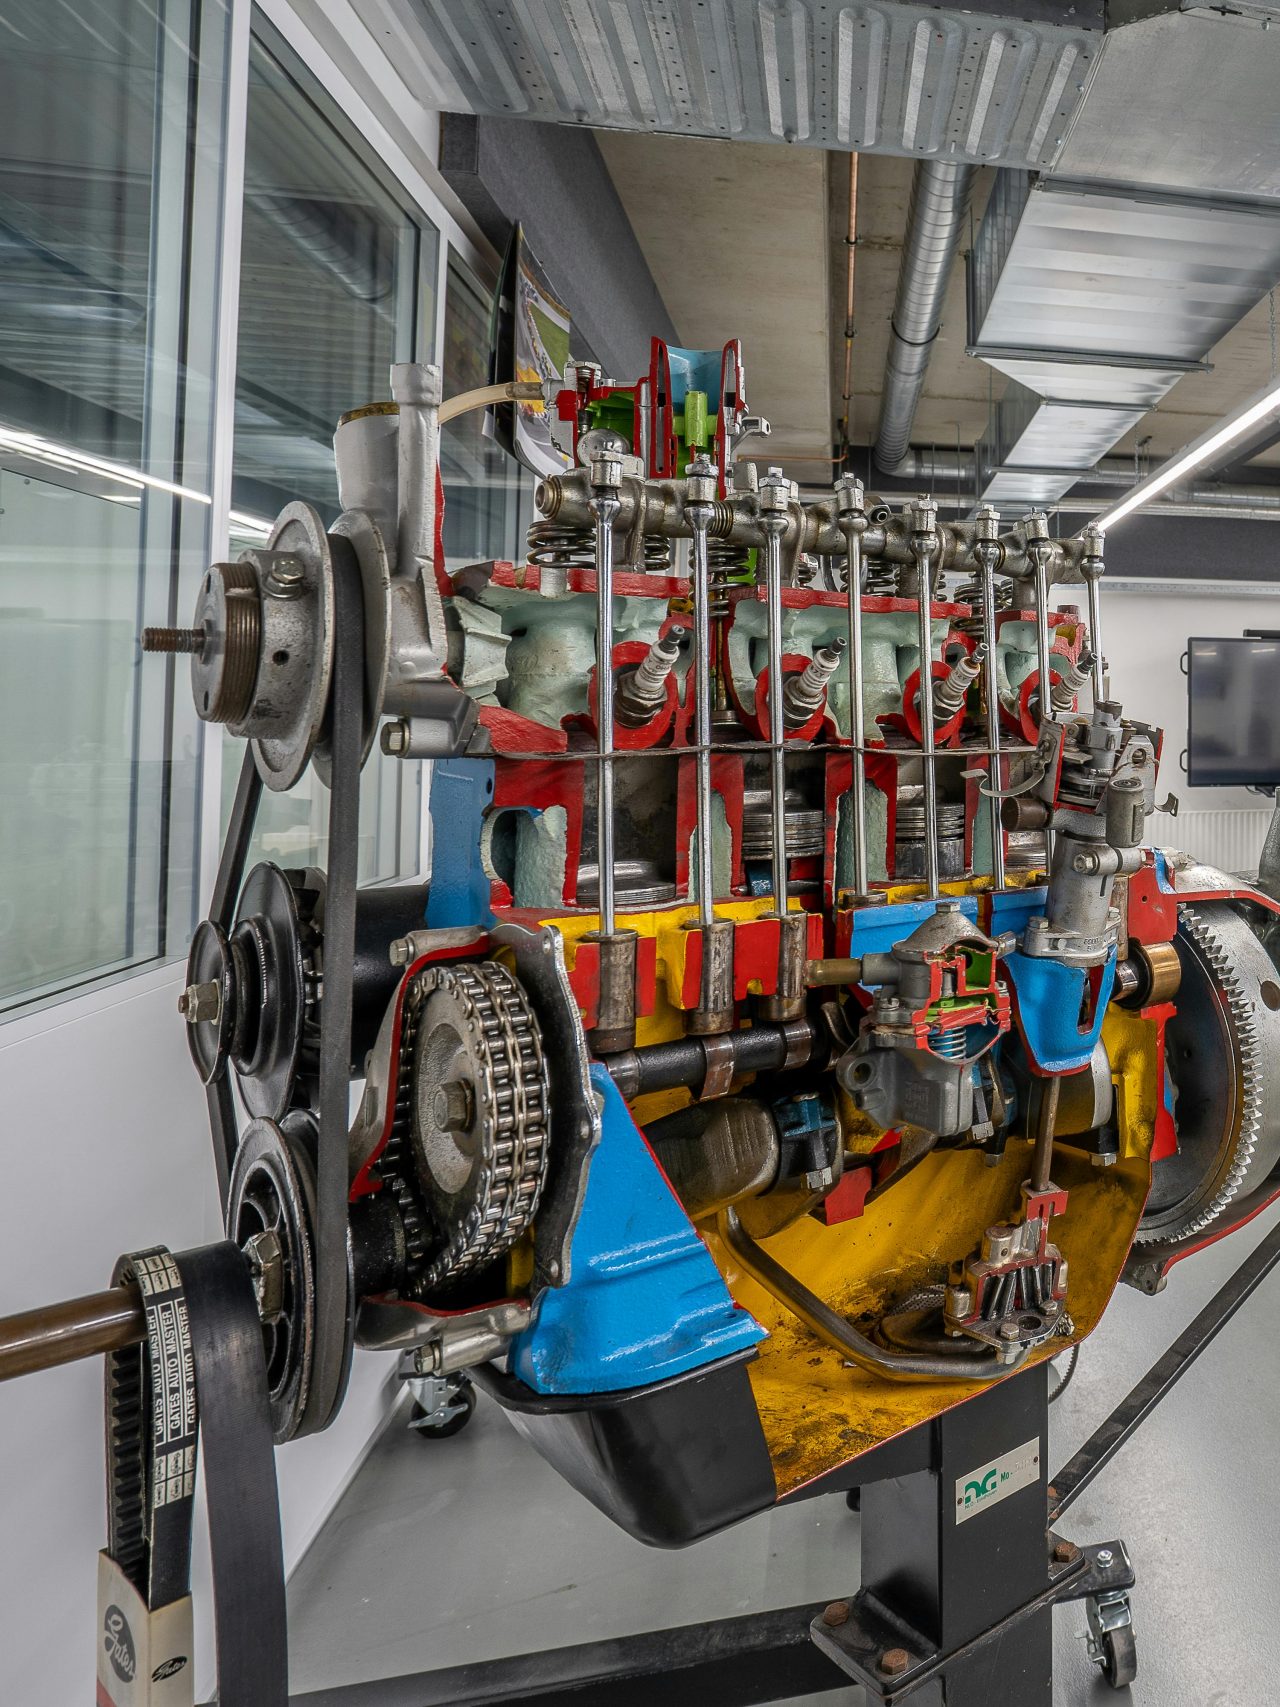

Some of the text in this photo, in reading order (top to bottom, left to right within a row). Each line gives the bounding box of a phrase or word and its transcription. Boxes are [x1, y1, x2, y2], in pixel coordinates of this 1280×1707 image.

[161, 1310, 182, 1430] GATES AUTO MASTER
[104, 1613, 137, 1676] Gates
